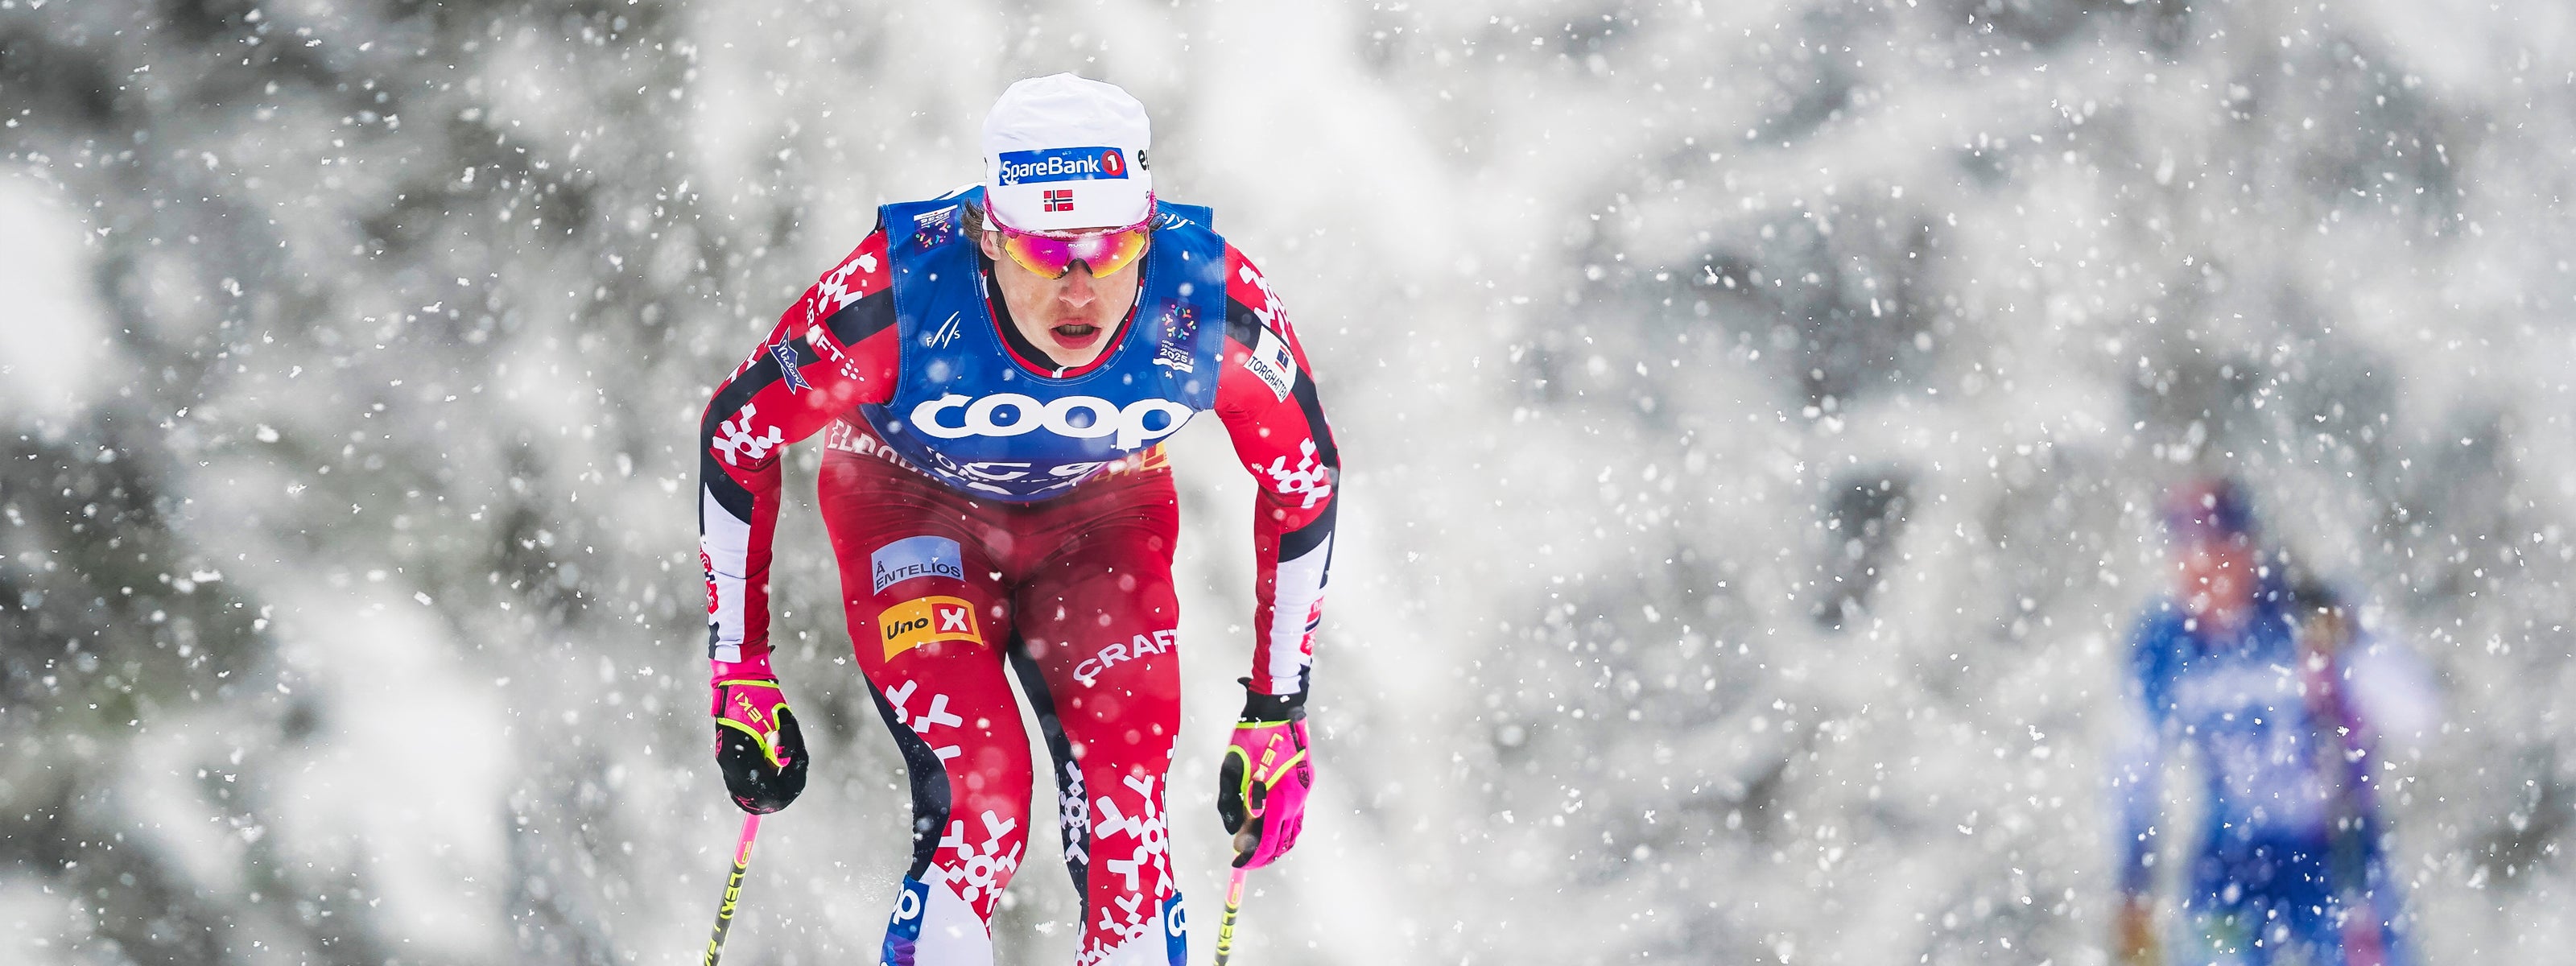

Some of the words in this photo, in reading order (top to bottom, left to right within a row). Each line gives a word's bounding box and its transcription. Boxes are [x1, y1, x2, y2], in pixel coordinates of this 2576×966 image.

[1001, 155, 1101, 183] SpareBank
[1106, 154, 1118, 171] 1
[1160, 349, 1187, 362] 2025
[1249, 356, 1288, 400] TORGHATTEN
[910, 393, 1194, 450] coop
[876, 563, 961, 590] ENTELIOS
[886, 617, 929, 640] Uno
[939, 607, 968, 631] X
[734, 691, 773, 737] LEKI
[719, 872, 745, 919] LEKI
